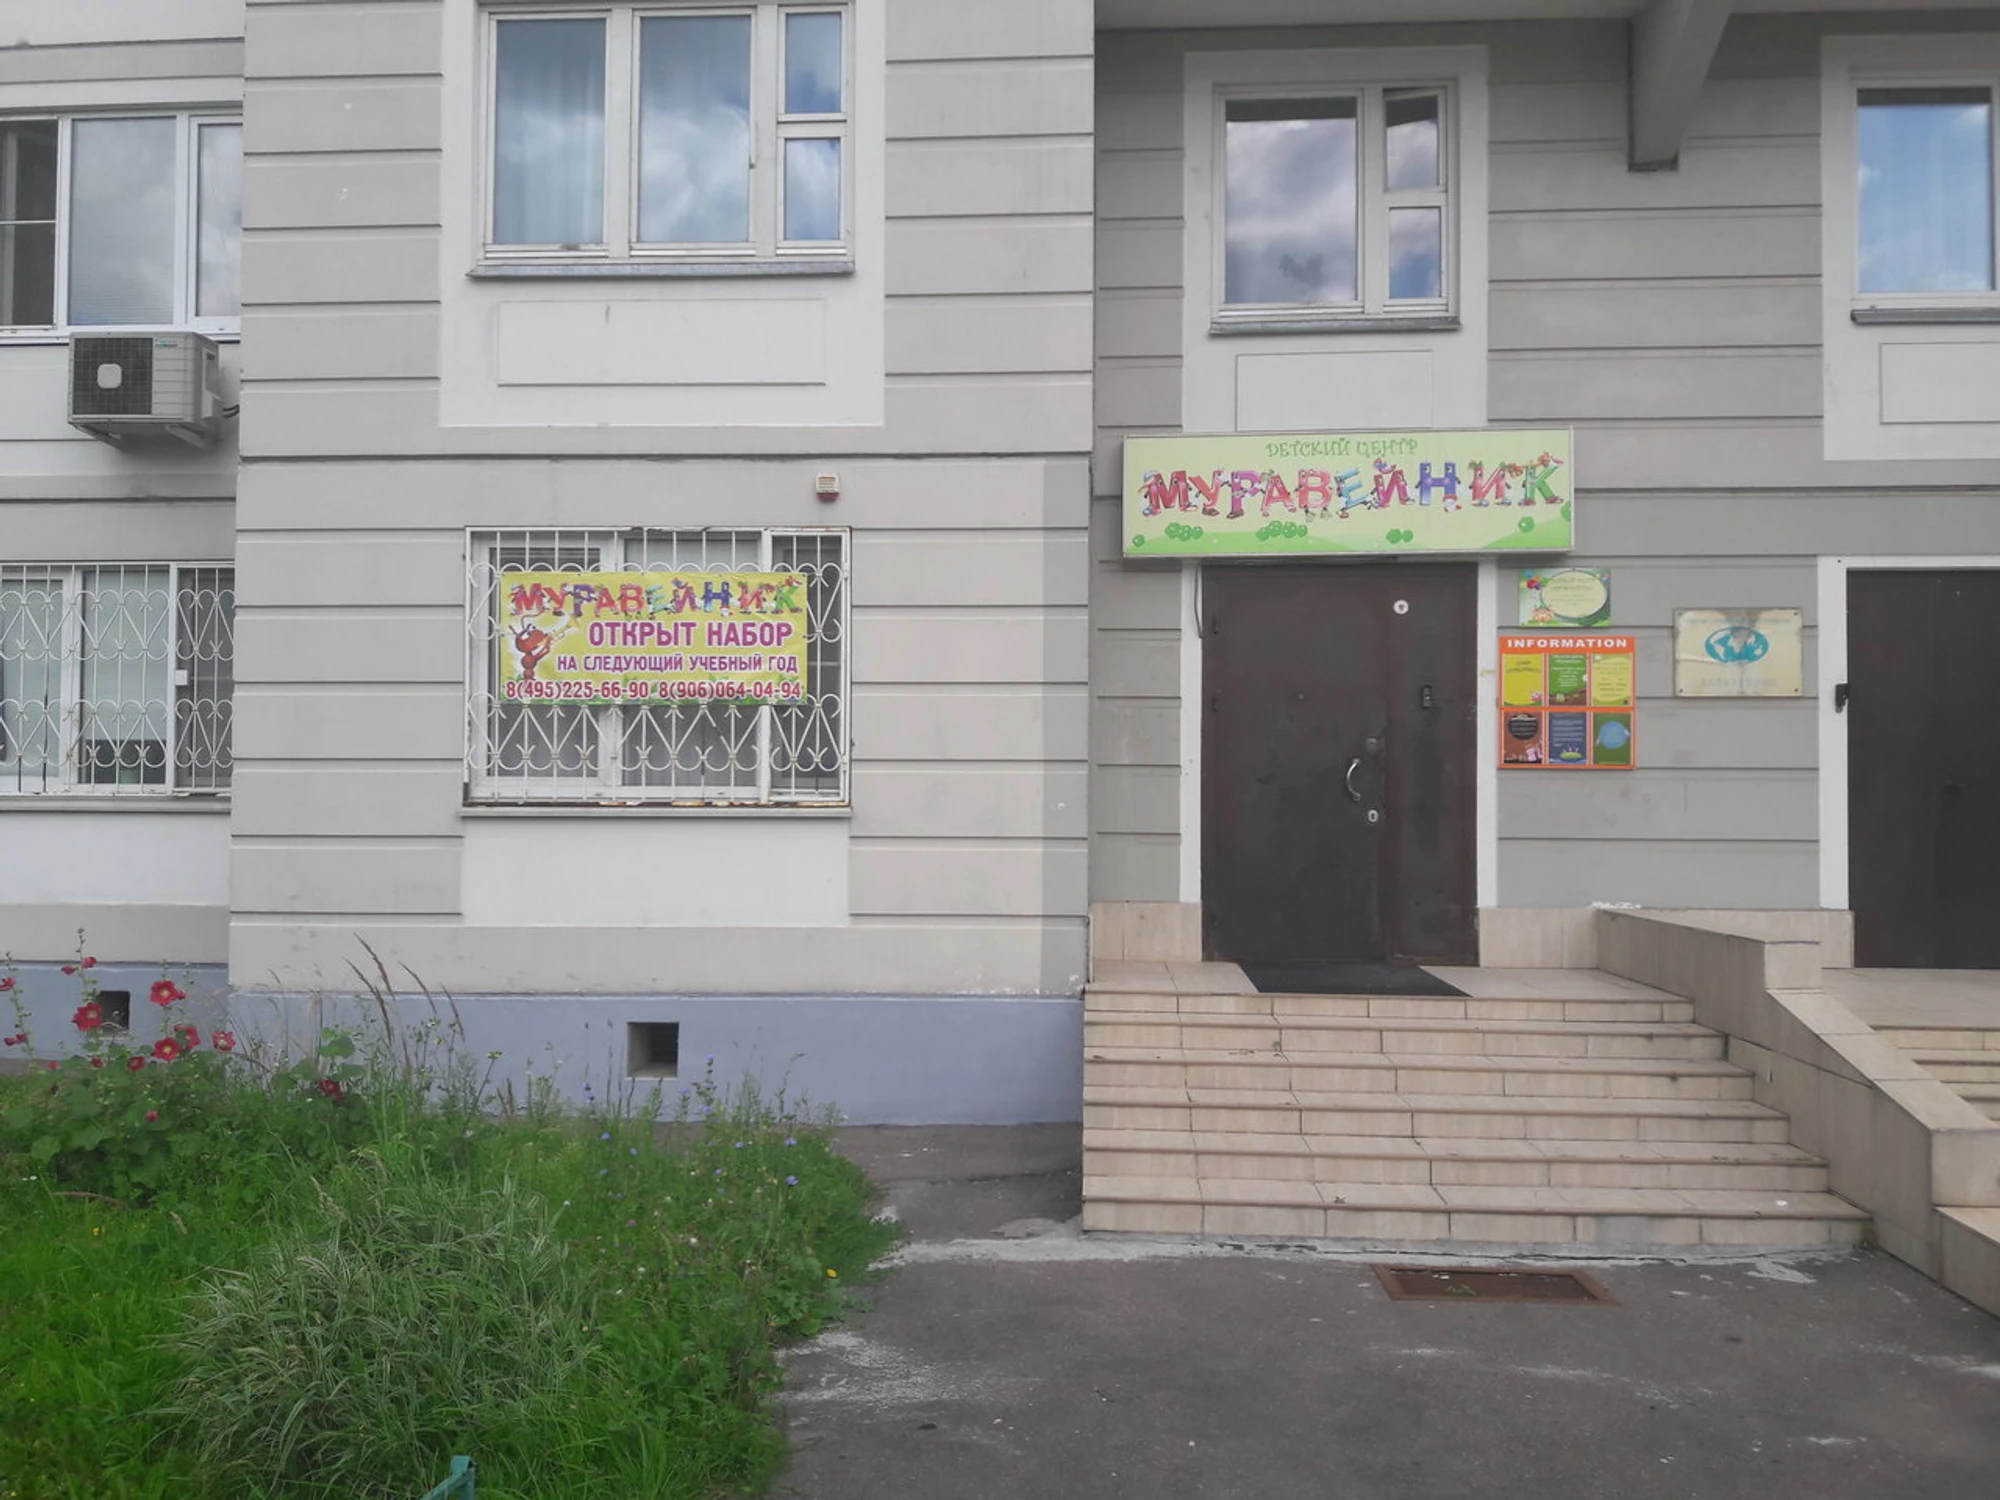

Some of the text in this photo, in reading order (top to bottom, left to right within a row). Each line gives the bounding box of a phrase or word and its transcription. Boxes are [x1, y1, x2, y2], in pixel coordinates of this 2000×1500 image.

[1266, 438, 1418, 458] ДЕТСКИЙ ЦЕНТР
[1142, 453, 1563, 520] МУРАВЕЙНИК
[510, 577, 804, 618] МУРАВЕЙНИК
[589, 622, 792, 647] ОТКРЫТ НАБОР
[1507, 638, 1628, 649] INFORMATION
[557, 653, 798, 673] НА СЛЕДУЮЩИЙ УЧЕБНЫЙ ГОД
[506, 681, 801, 699] 8(495)225-66-90 8(906)064-04-94
